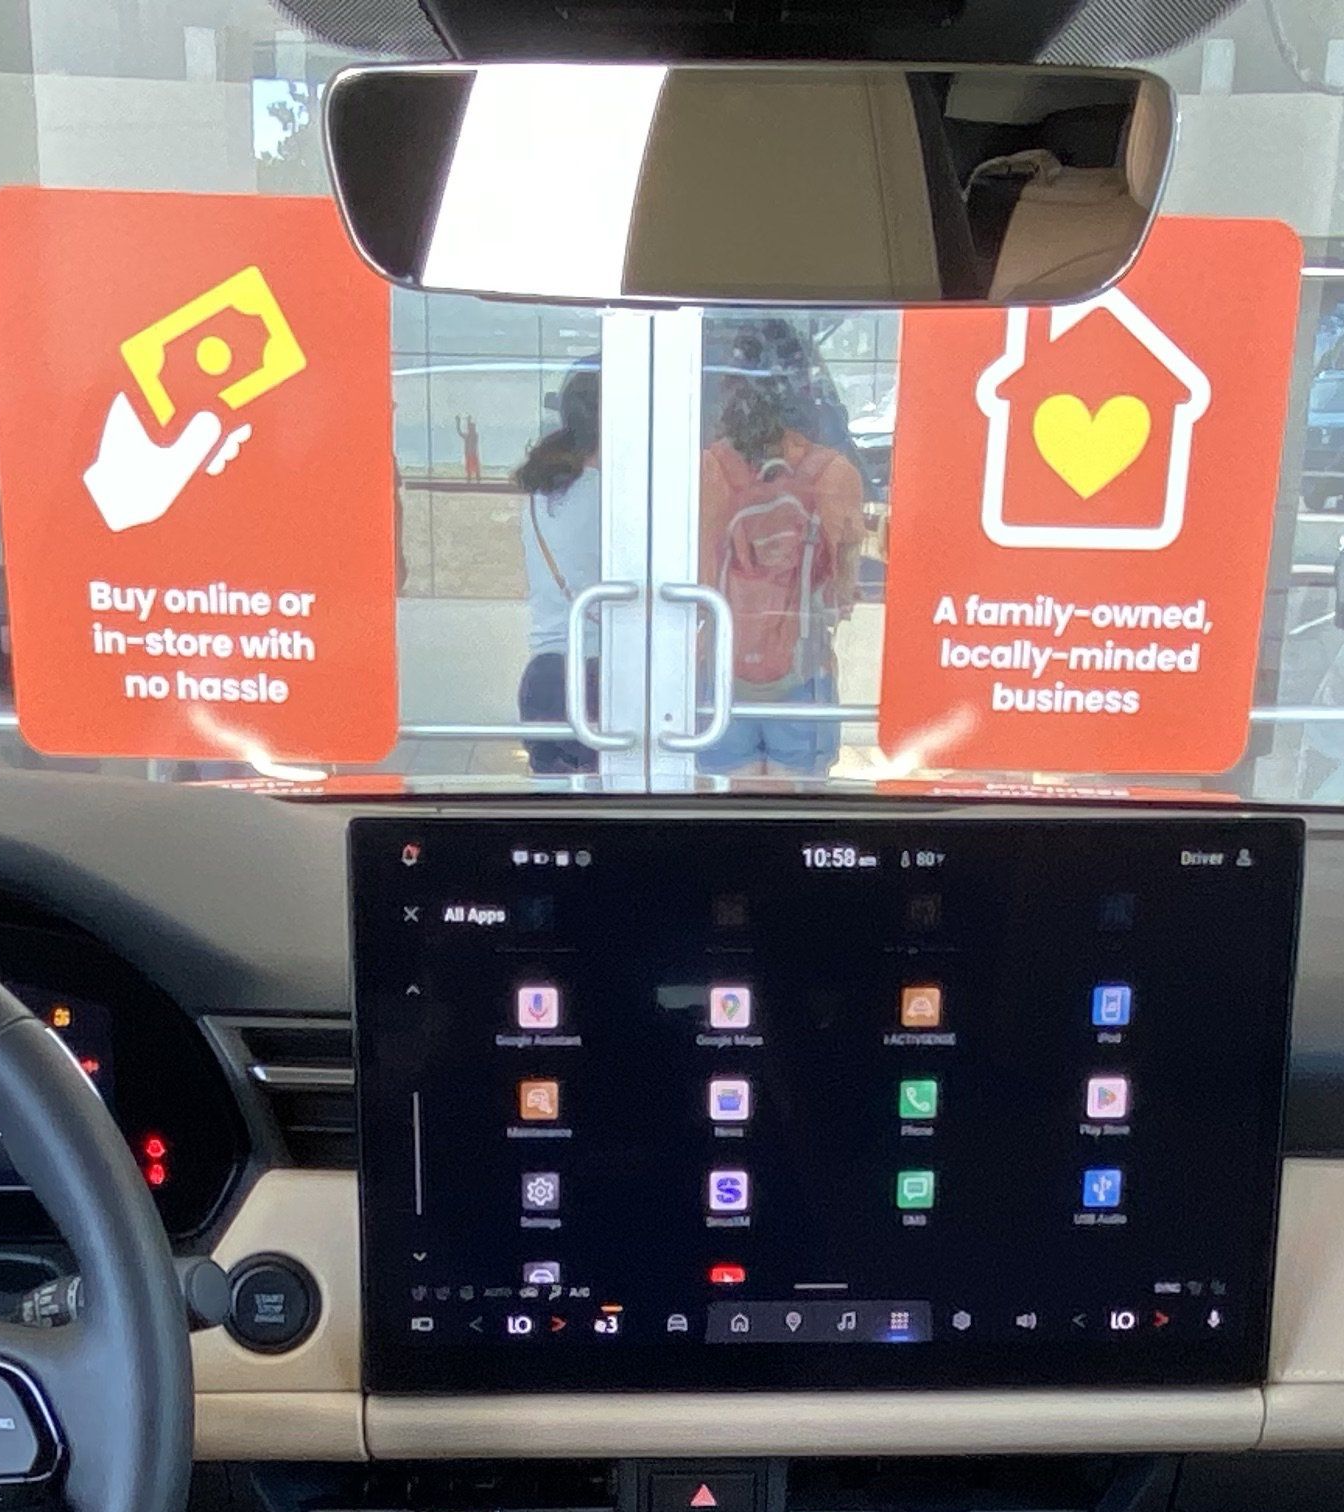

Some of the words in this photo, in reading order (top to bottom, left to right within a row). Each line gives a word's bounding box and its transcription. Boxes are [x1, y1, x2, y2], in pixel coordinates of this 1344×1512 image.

[88, 581, 157, 622] Buy
[164, 582, 272, 616] online
[278, 592, 316, 616] or
[932, 595, 957, 625] A
[965, 594, 1213, 637] family-owned,
[92, 622, 234, 657] in-store
[240, 628, 316, 661] with
[939, 638, 1201, 679] locally-minded
[124, 674, 170, 699] no
[176, 670, 290, 704] hassle
[991, 681, 1141, 714] business
[802, 848, 856, 868] 10:58
[1180, 850, 1224, 866] Driver
[444, 907, 464, 922] All
[467, 907, 506, 925] Apps
[507, 1316, 533, 1334] LO
[1110, 1311, 1136, 1330] LO
